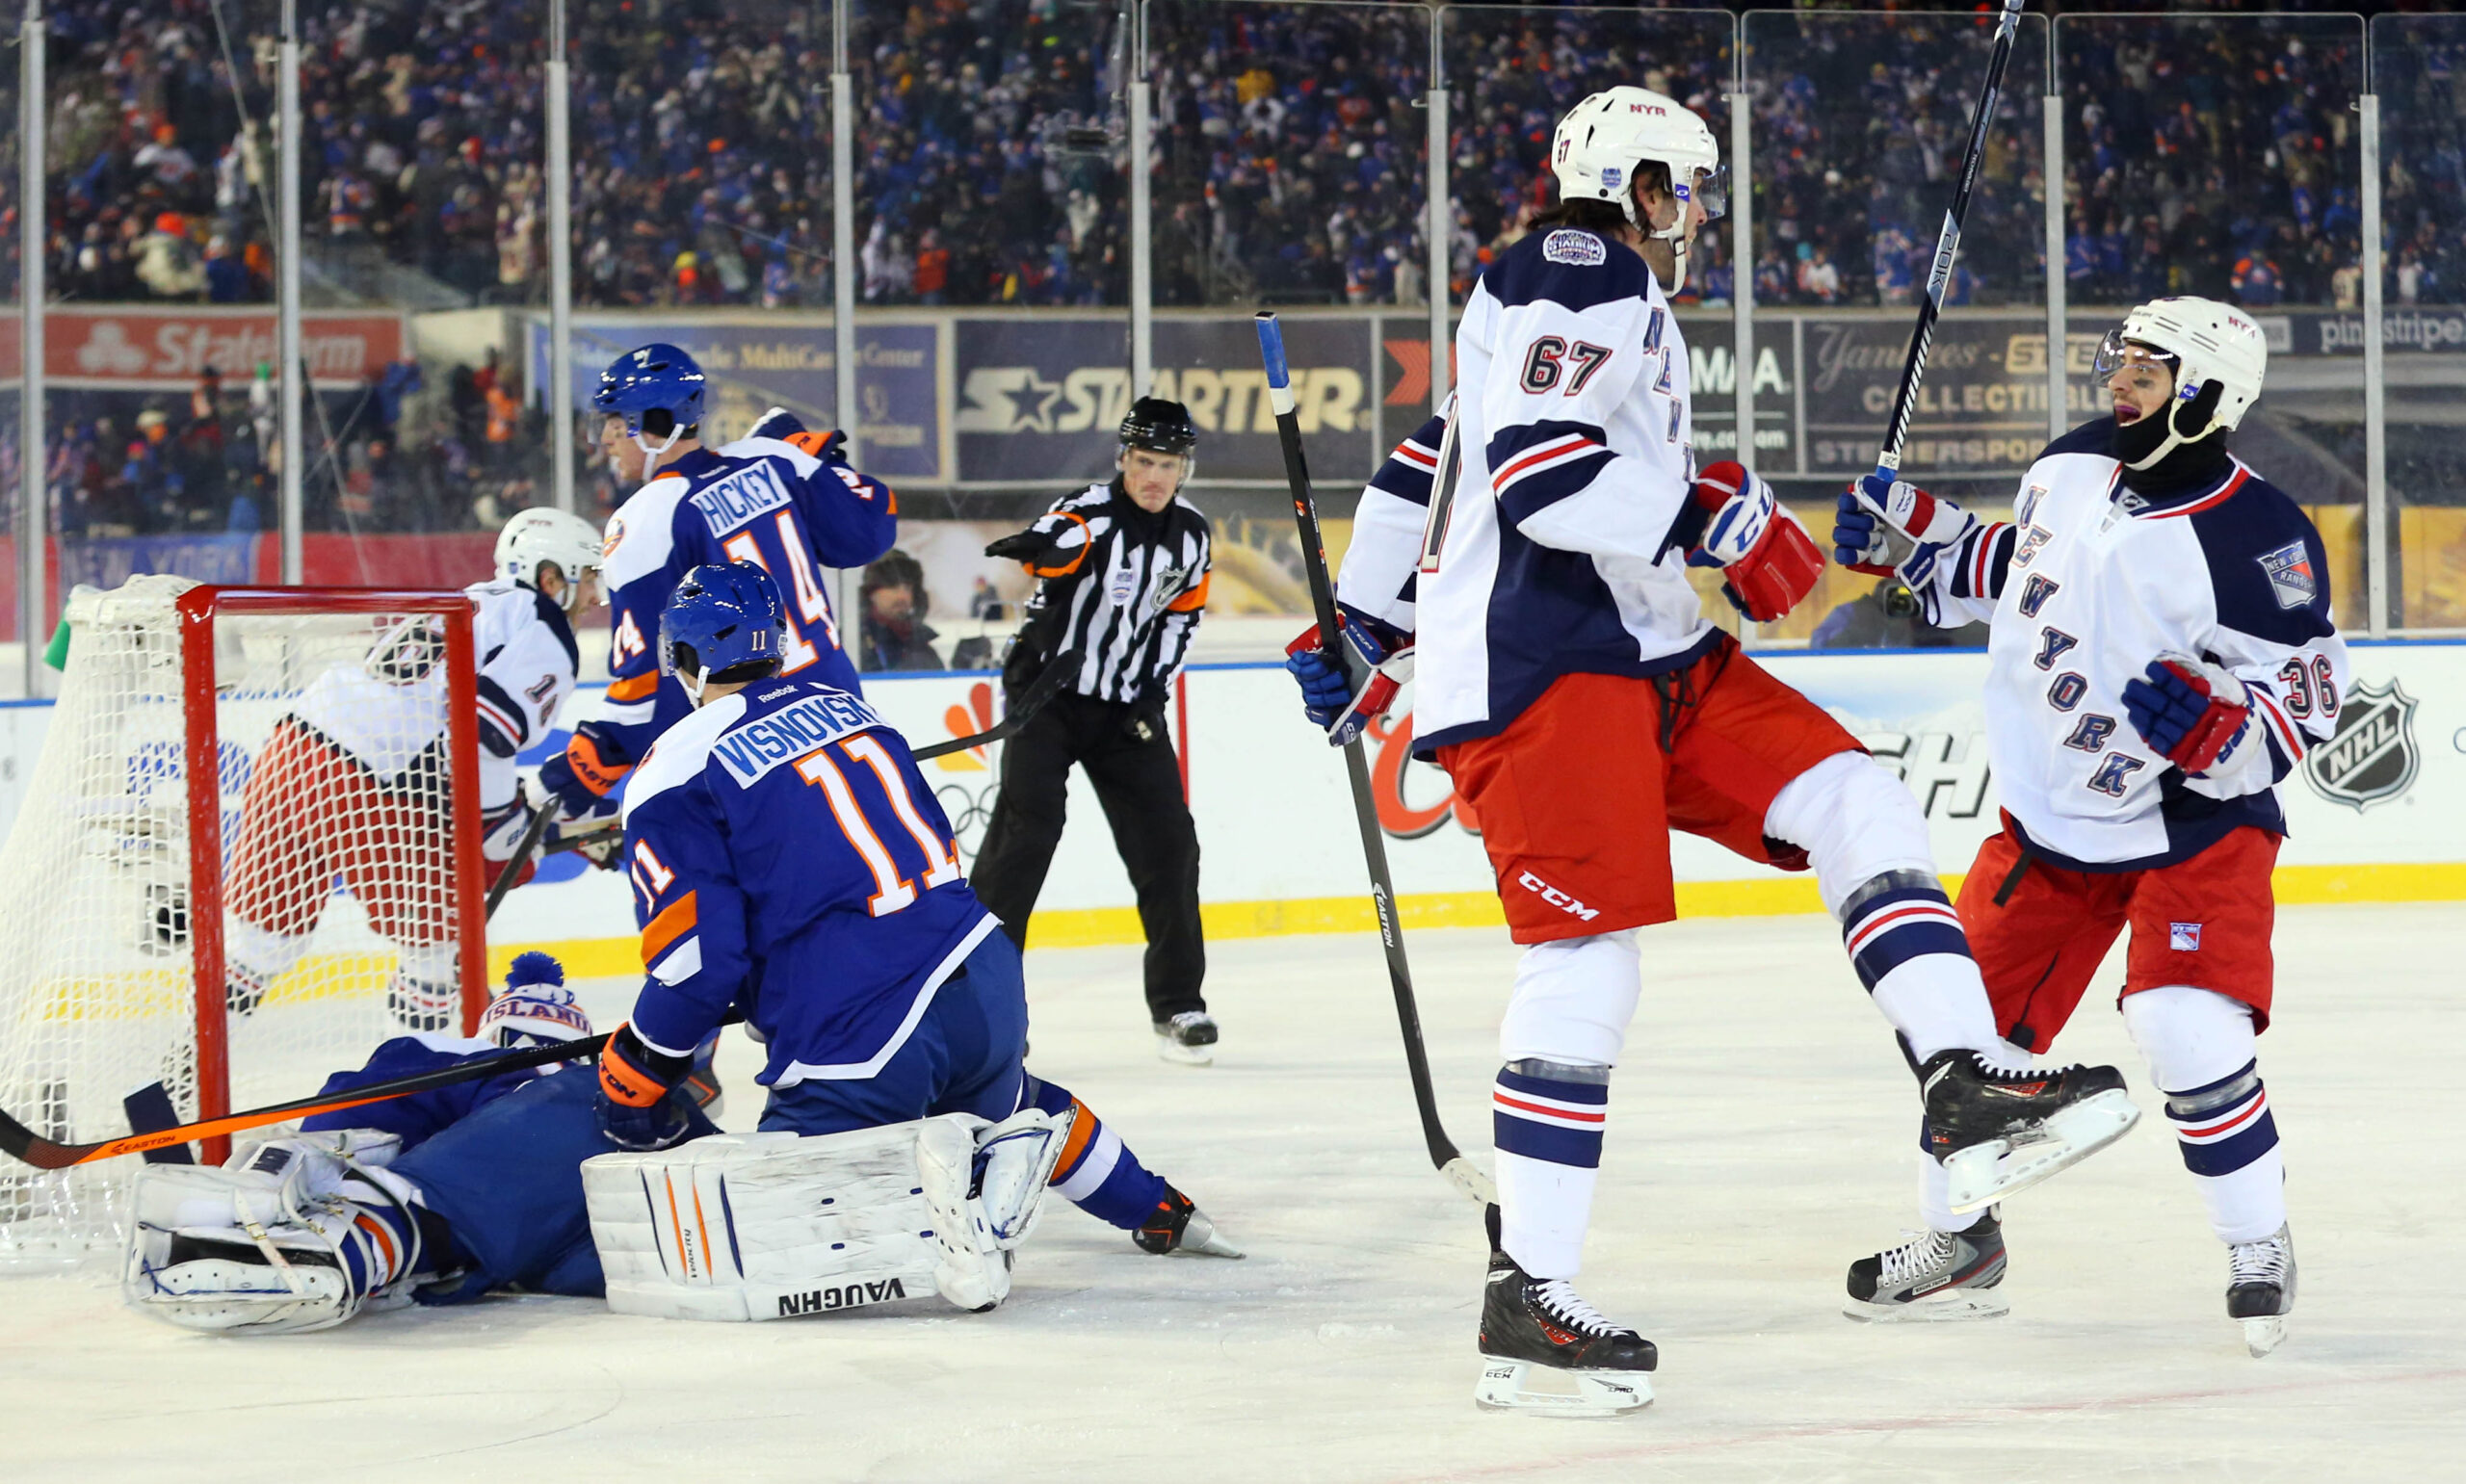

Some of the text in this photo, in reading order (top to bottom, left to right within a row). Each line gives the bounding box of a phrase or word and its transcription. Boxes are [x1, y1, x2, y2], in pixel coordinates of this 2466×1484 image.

[1630, 103, 1666, 117] NYR
[864, 342, 925, 369] Center
[1520, 335, 1613, 397] 67
[695, 464, 781, 533] HICKEY
[2010, 485, 2059, 618] NEW
[722, 508, 842, 677] 14
[751, 630, 767, 652] 11
[759, 684, 799, 705] Reebok
[2033, 626, 2147, 798] YORK
[2279, 654, 2339, 720] 36
[2328, 714, 2397, 781] NHL
[793, 732, 961, 918] 11
[1376, 892, 1395, 948] EASTON
[1518, 870, 1600, 922] CCM
[123, 1134, 176, 1153] EASTON
[778, 1277, 906, 1316] VAUGHN
